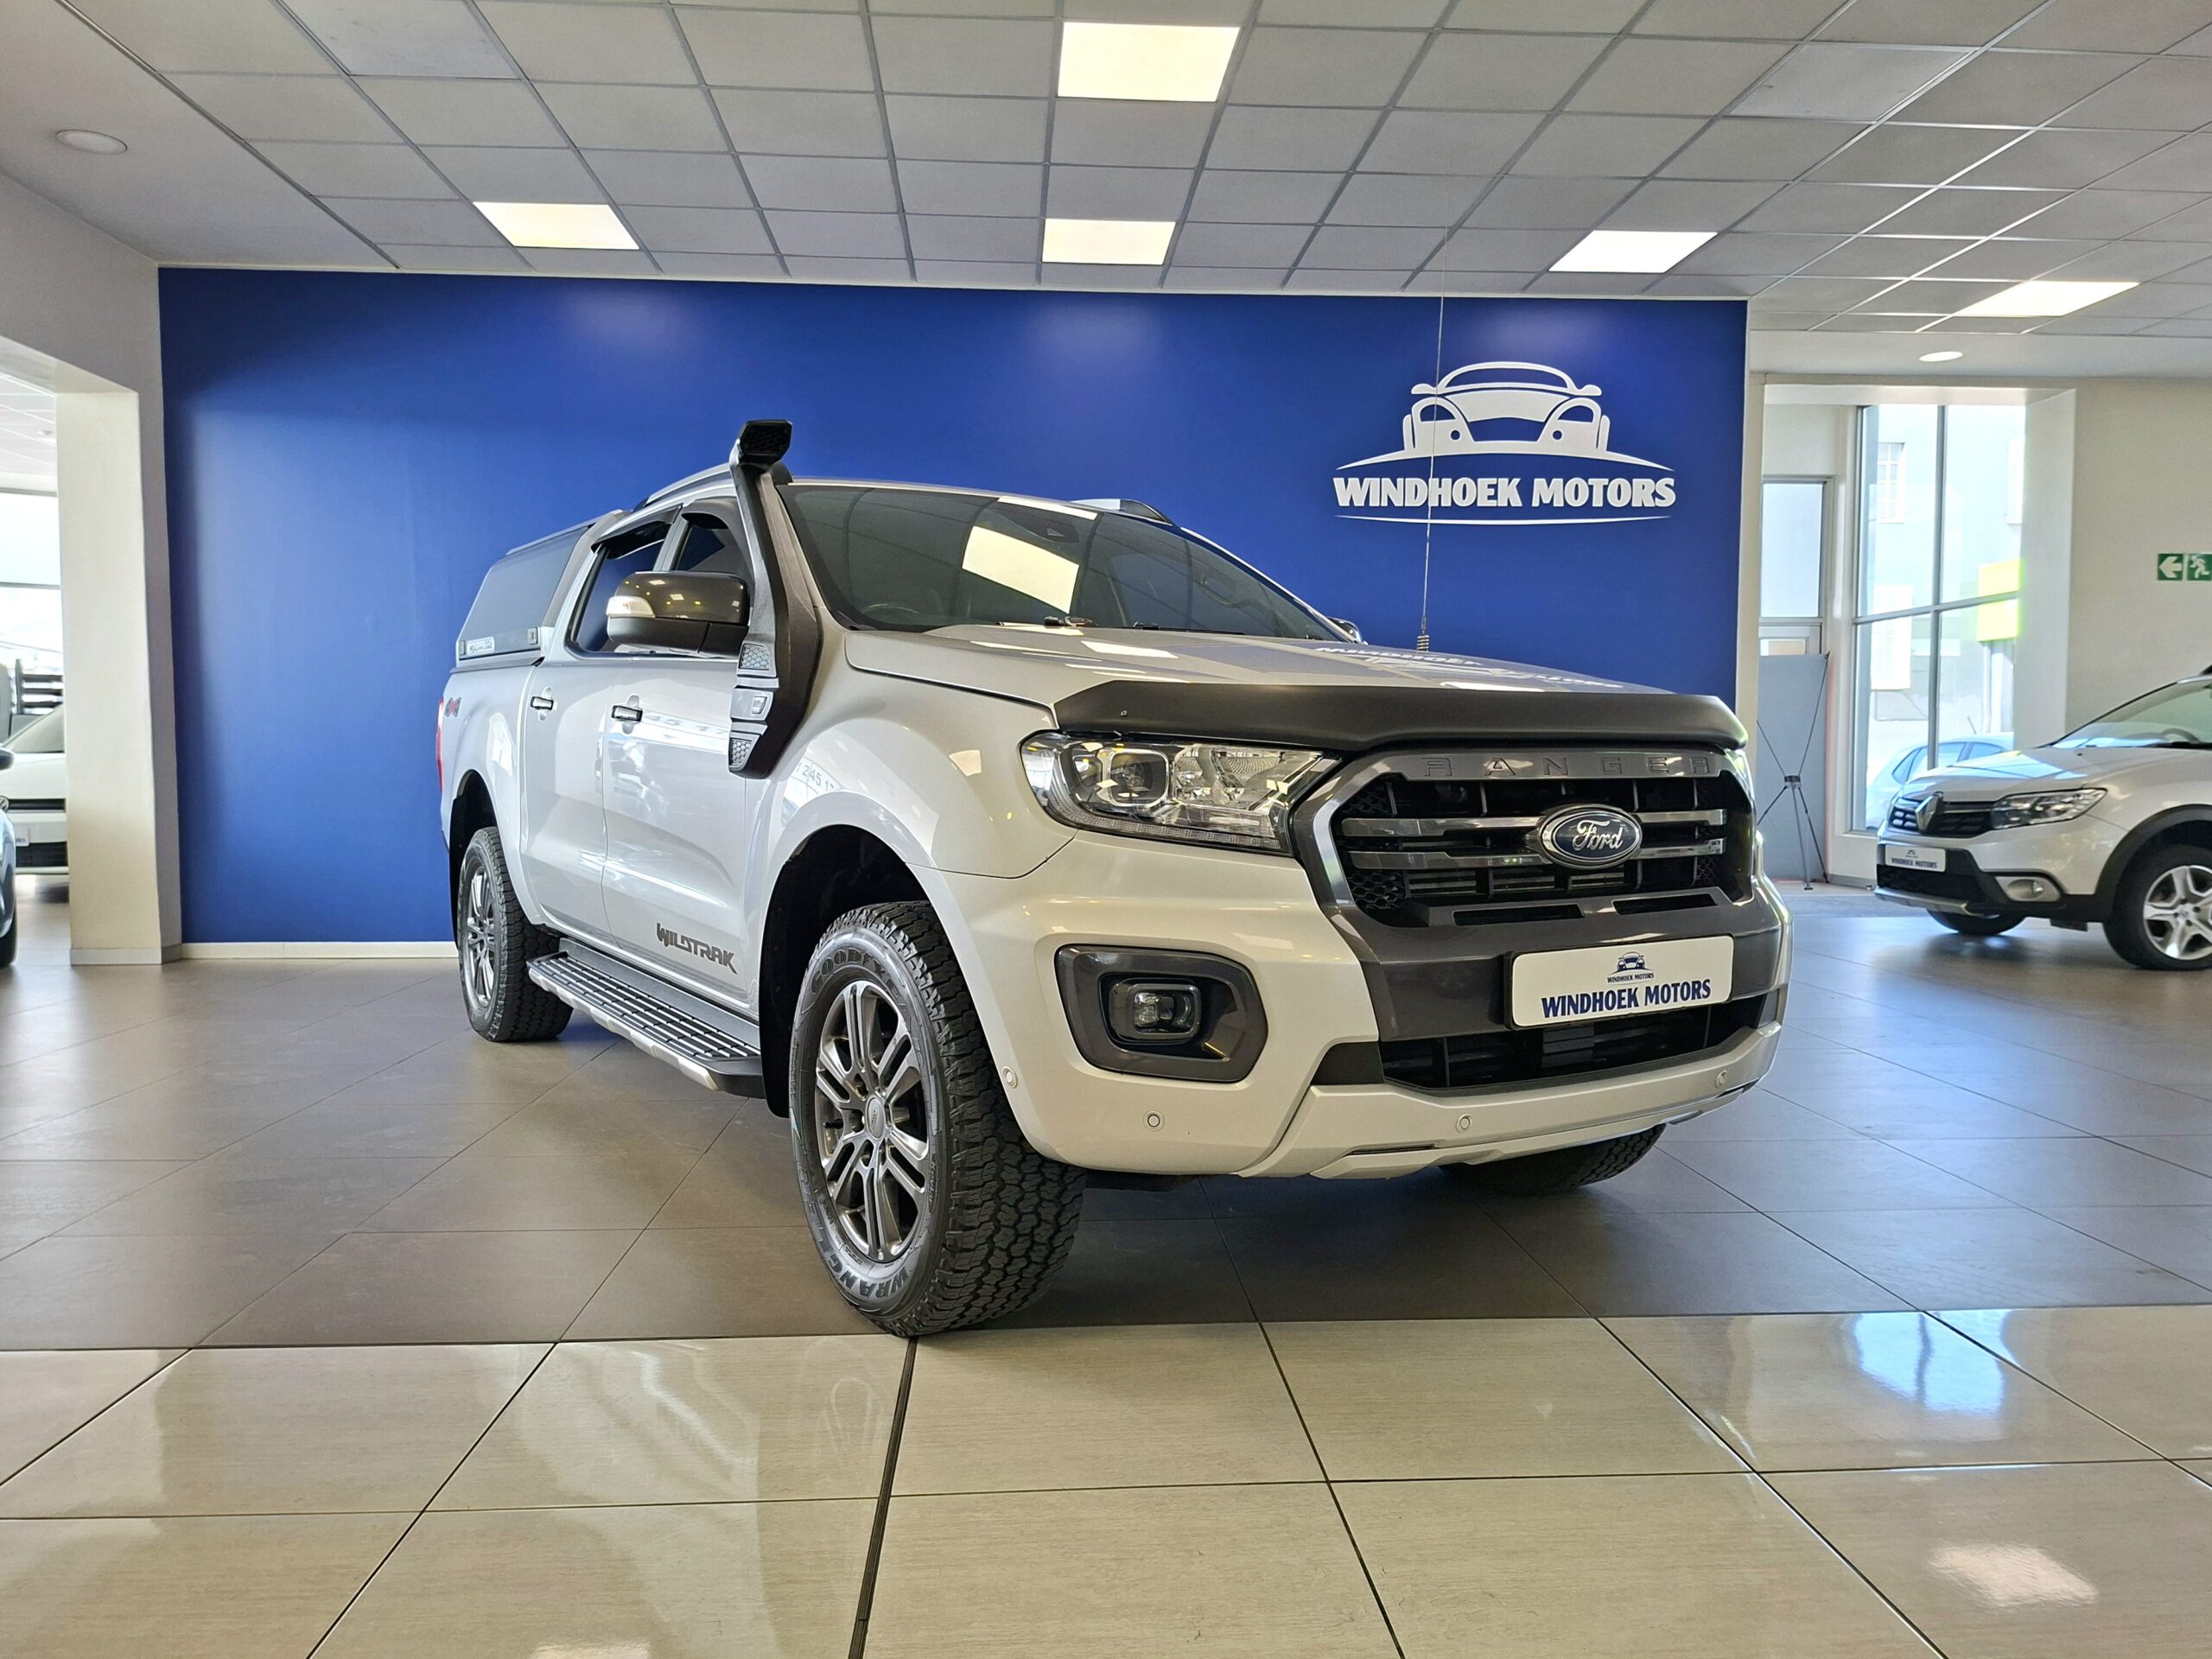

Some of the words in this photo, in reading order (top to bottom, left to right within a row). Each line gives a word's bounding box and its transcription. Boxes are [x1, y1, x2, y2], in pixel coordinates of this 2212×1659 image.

[1332, 477, 1522, 507] WINDHOEK
[1532, 477, 1676, 507] MOTORS
[1421, 756, 1710, 777] RANGER
[1572, 819, 1624, 851] Ford
[657, 922, 738, 975] WILDTRAK
[1607, 975, 1633, 983] WINDHOEK
[1634, 972, 1655, 981] MOTORS
[1541, 987, 1640, 1019] WINDHOEK
[1644, 978, 1712, 1007] MOTORS
